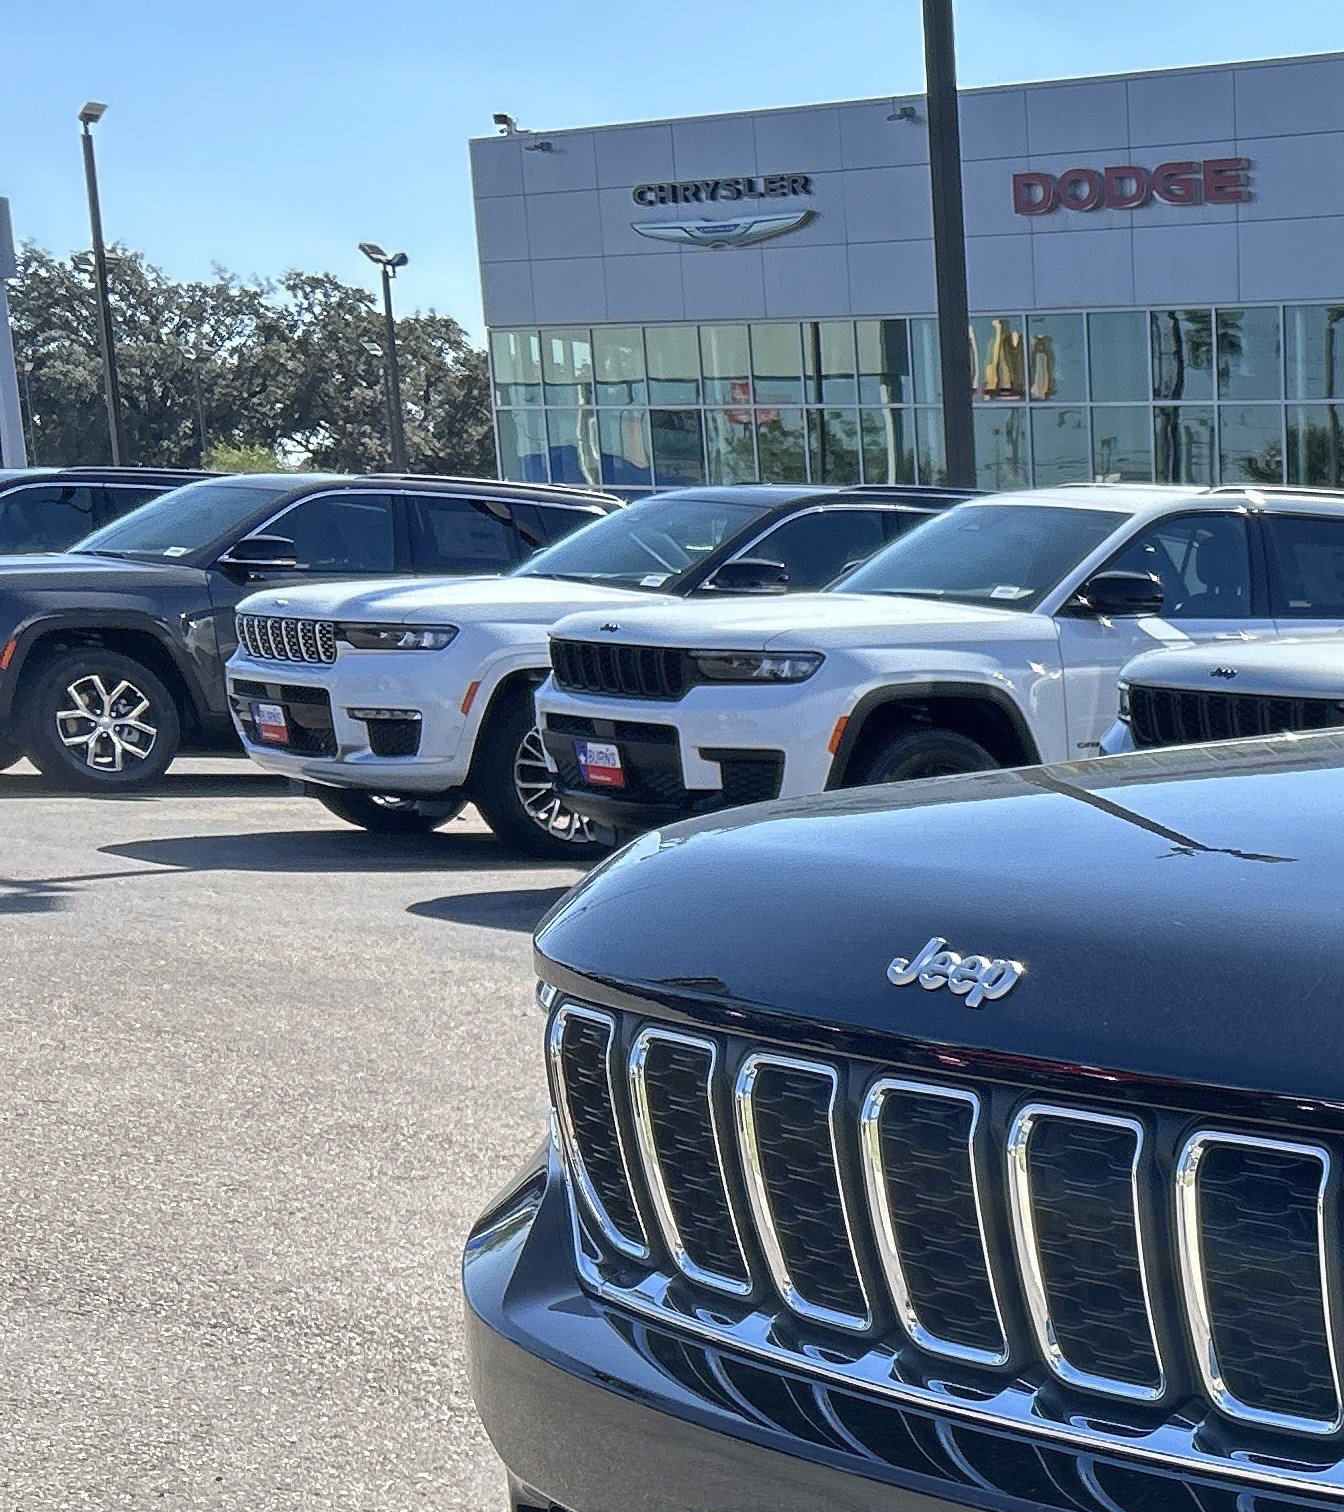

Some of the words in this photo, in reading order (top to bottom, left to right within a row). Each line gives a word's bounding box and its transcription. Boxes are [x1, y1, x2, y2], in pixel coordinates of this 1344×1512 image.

[633, 175, 813, 206] CHRYSLER
[1012, 157, 1253, 215] DODGE
[887, 936, 1028, 1008] Jeep
